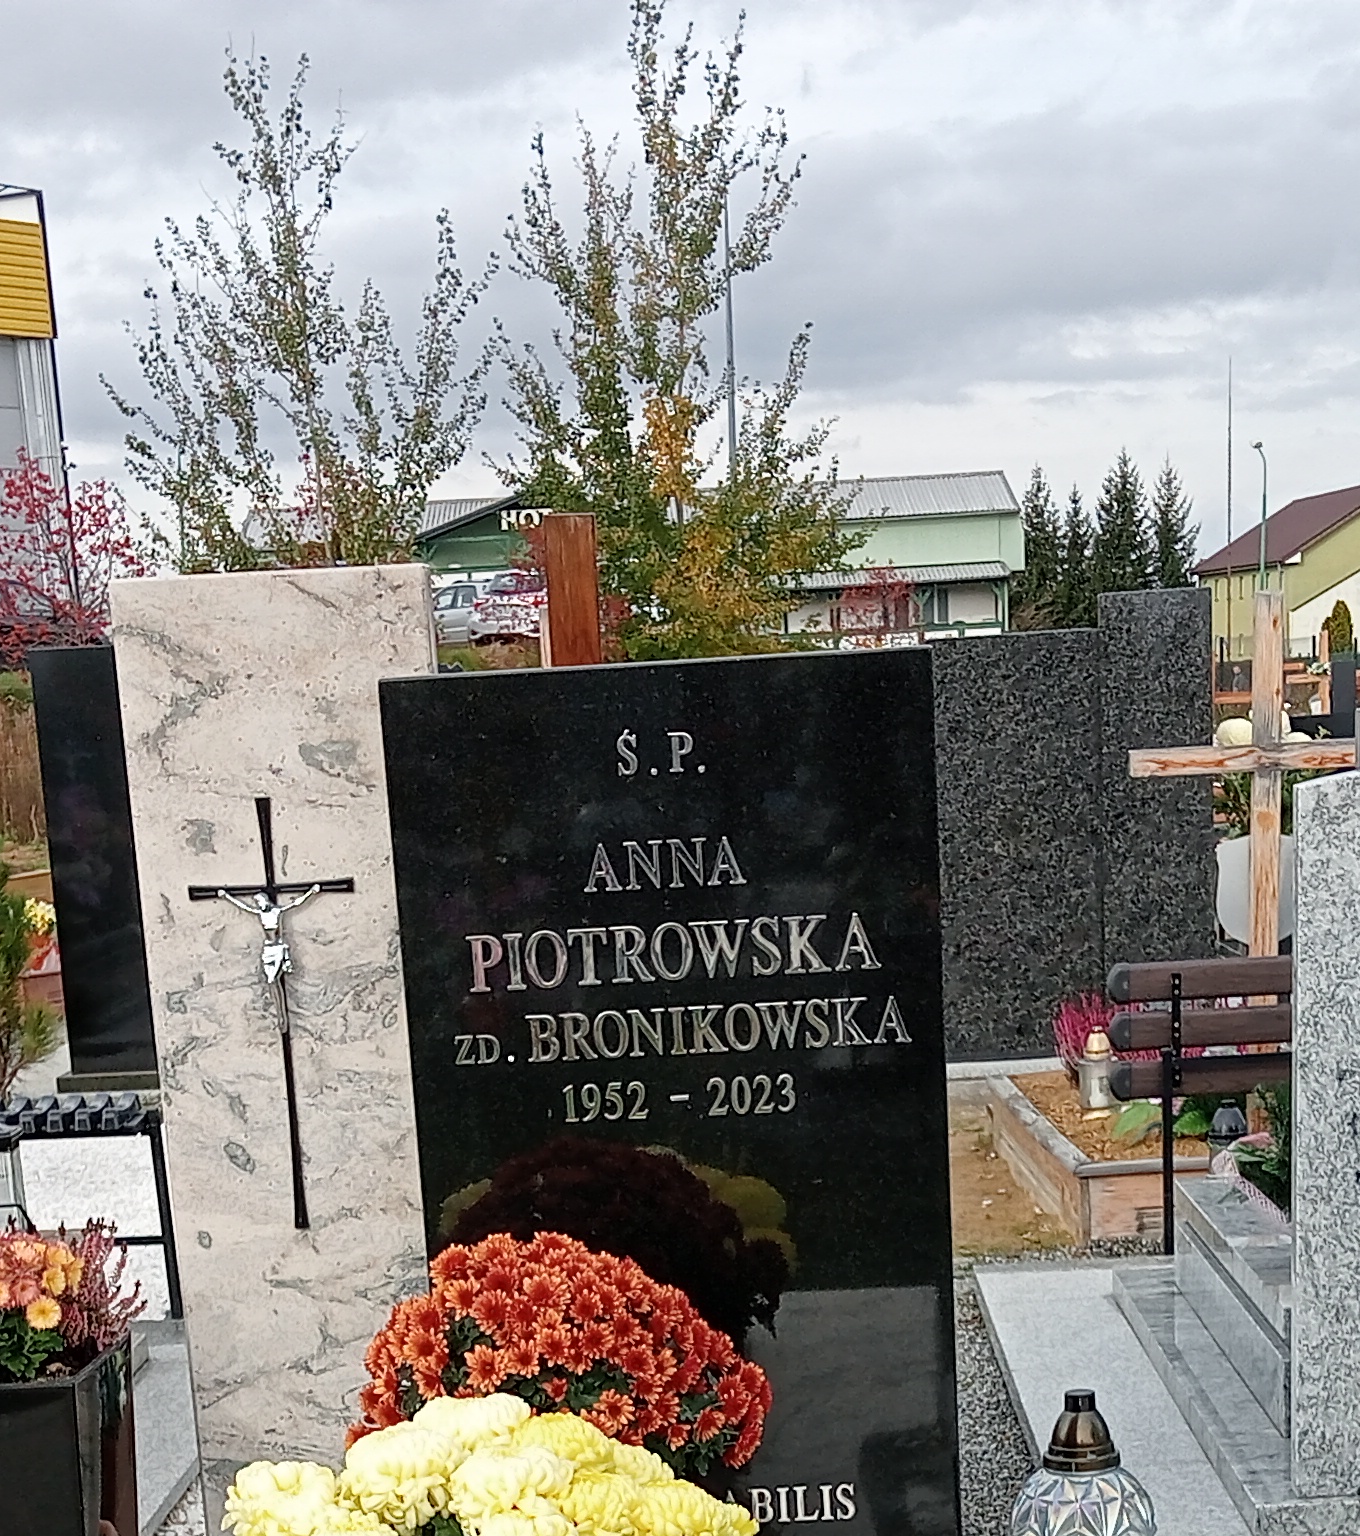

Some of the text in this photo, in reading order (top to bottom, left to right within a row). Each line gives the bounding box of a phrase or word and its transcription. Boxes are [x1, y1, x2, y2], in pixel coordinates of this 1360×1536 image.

[583, 835, 747, 893] ANNA
[465, 911, 882, 994] PIOTROWSKA
[453, 995, 913, 1065] ZD. BRONIKOWSKA
[562, 1080, 650, 1123] 1952
[706, 1073, 797, 1117] 2023
